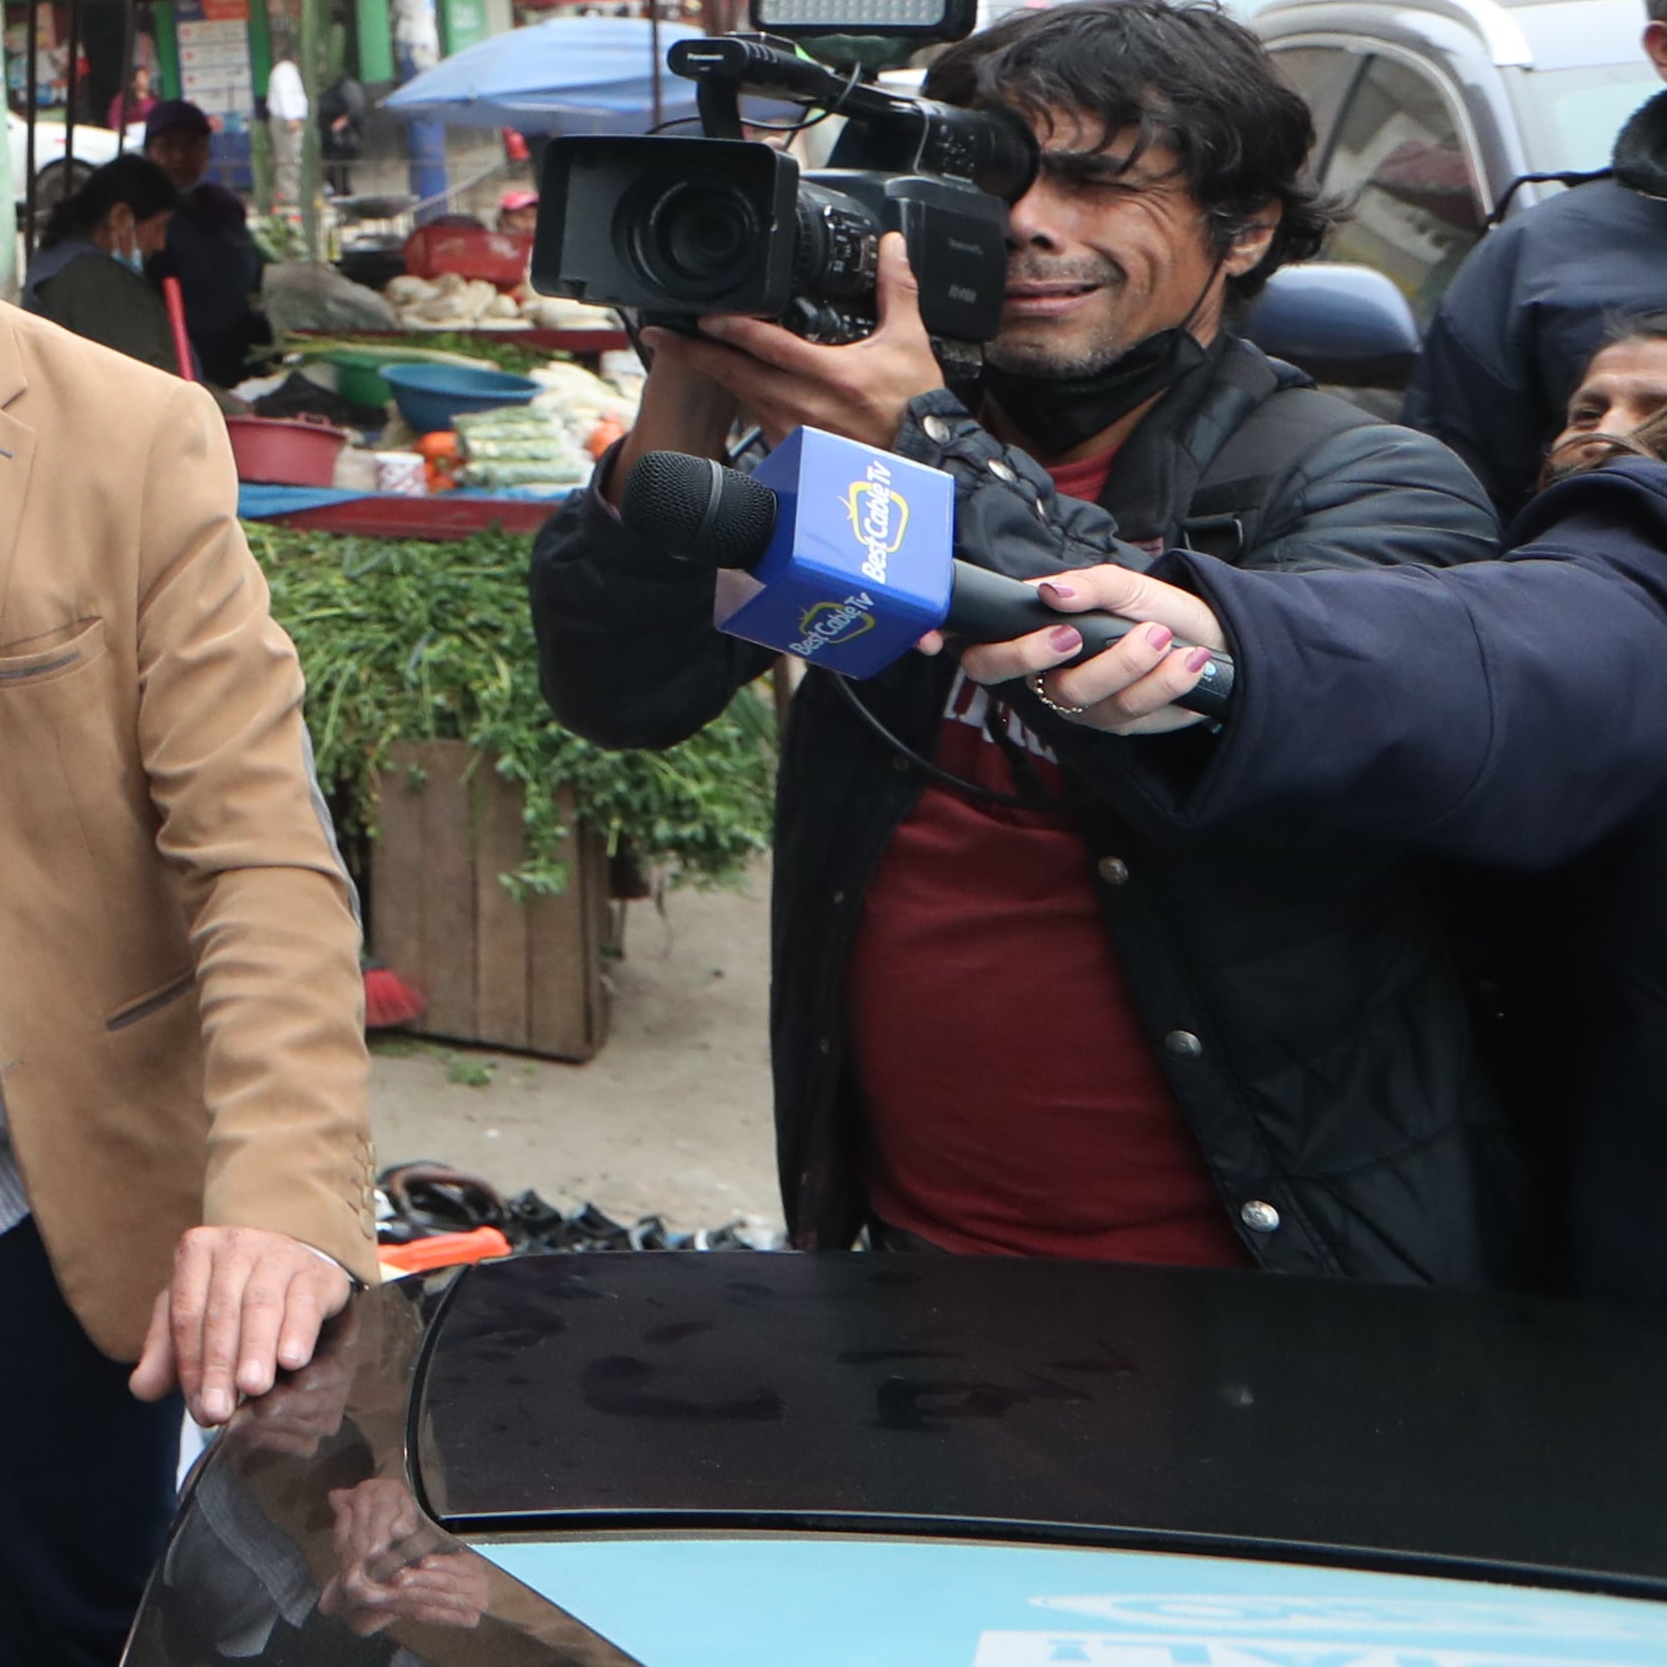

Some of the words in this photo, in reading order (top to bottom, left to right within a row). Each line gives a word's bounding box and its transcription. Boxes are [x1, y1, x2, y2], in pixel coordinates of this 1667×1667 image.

[863, 484, 892, 538] Cable
[861, 540, 889, 585] Best
[789, 630, 824, 656] Best
[813, 602, 861, 638] Cable
